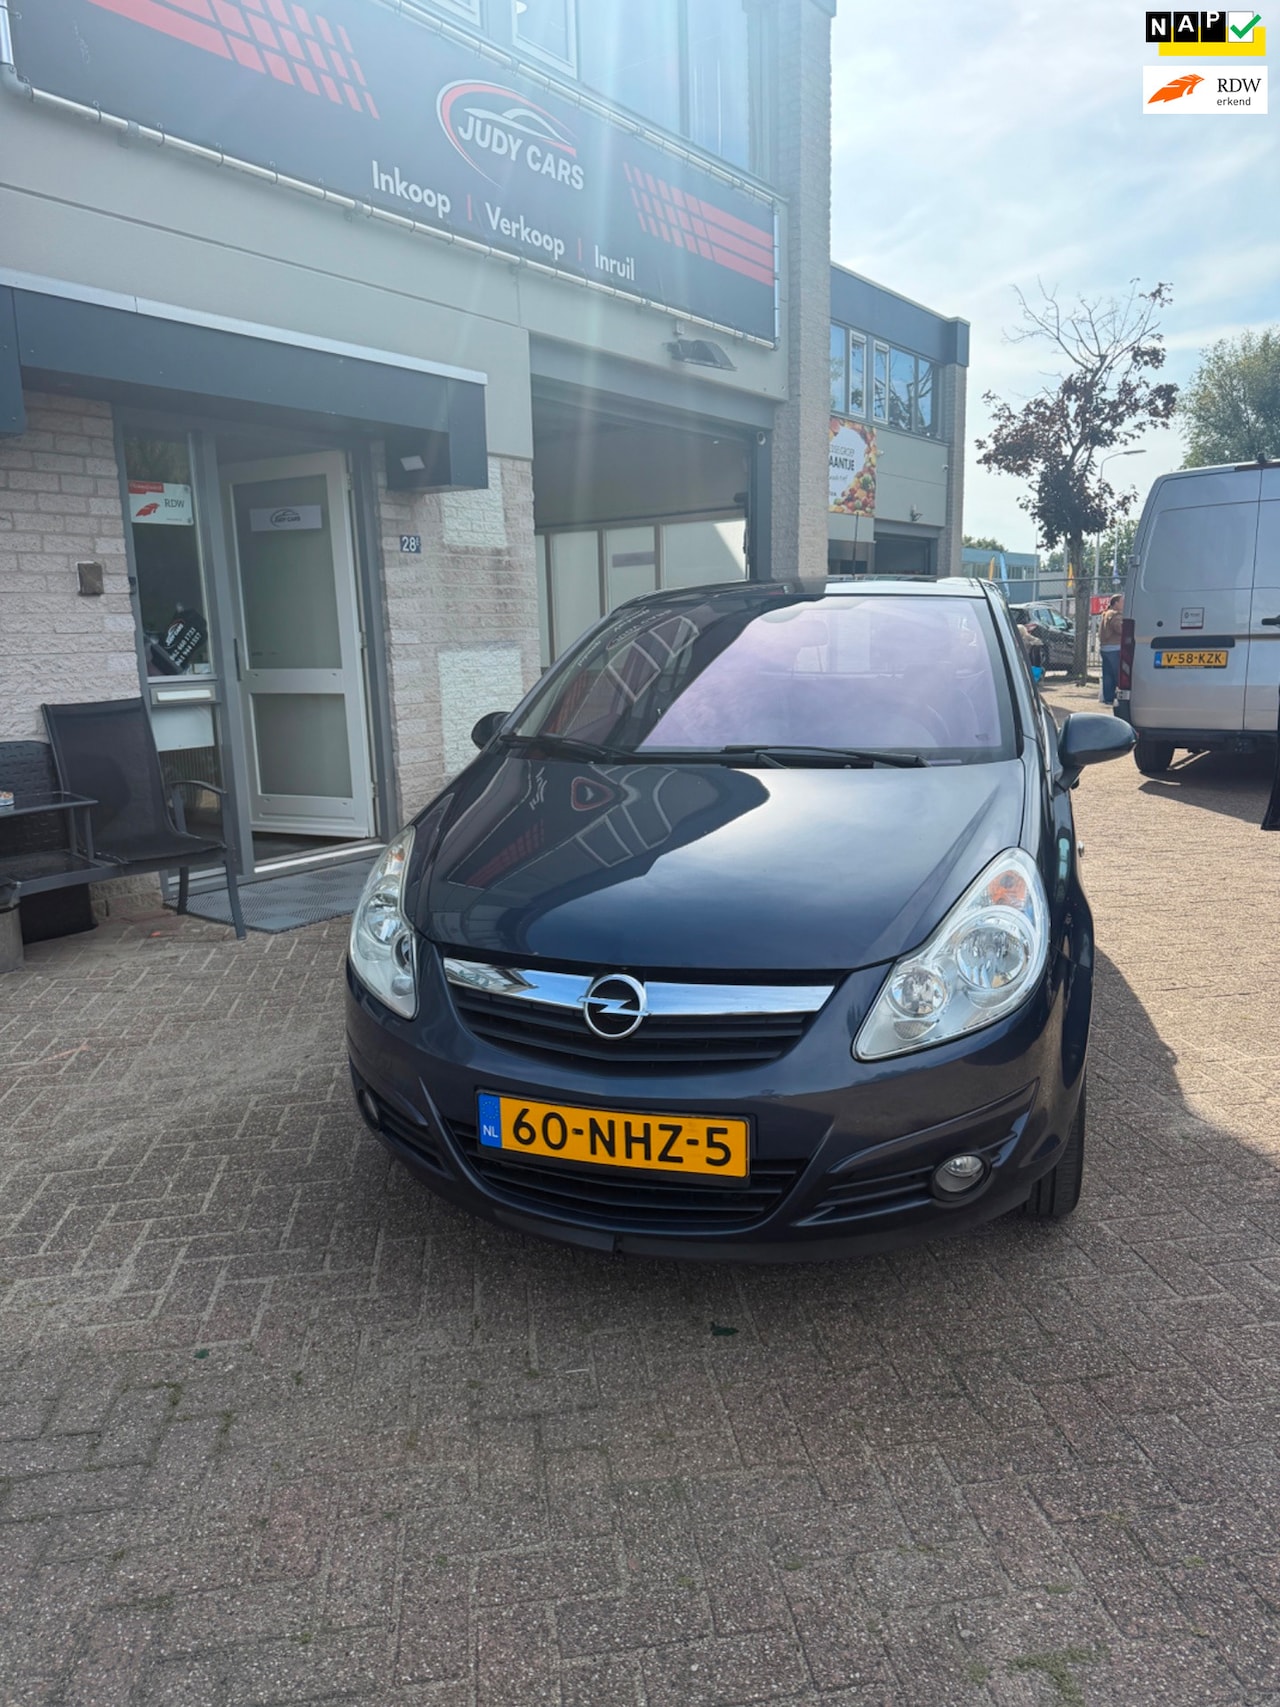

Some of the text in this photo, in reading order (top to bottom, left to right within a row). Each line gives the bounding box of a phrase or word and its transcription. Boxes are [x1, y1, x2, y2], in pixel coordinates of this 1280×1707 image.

[458, 116, 585, 190] JUDY CARS
[372, 160, 635, 281] Inkoop Verkoop Inruil
[164, 498, 185, 508] RDW
[1166, 653, 1222, 664] V-58-KZK
[483, 1124, 499, 1138] NL
[513, 1108, 732, 1167] 60-NHZ-5
